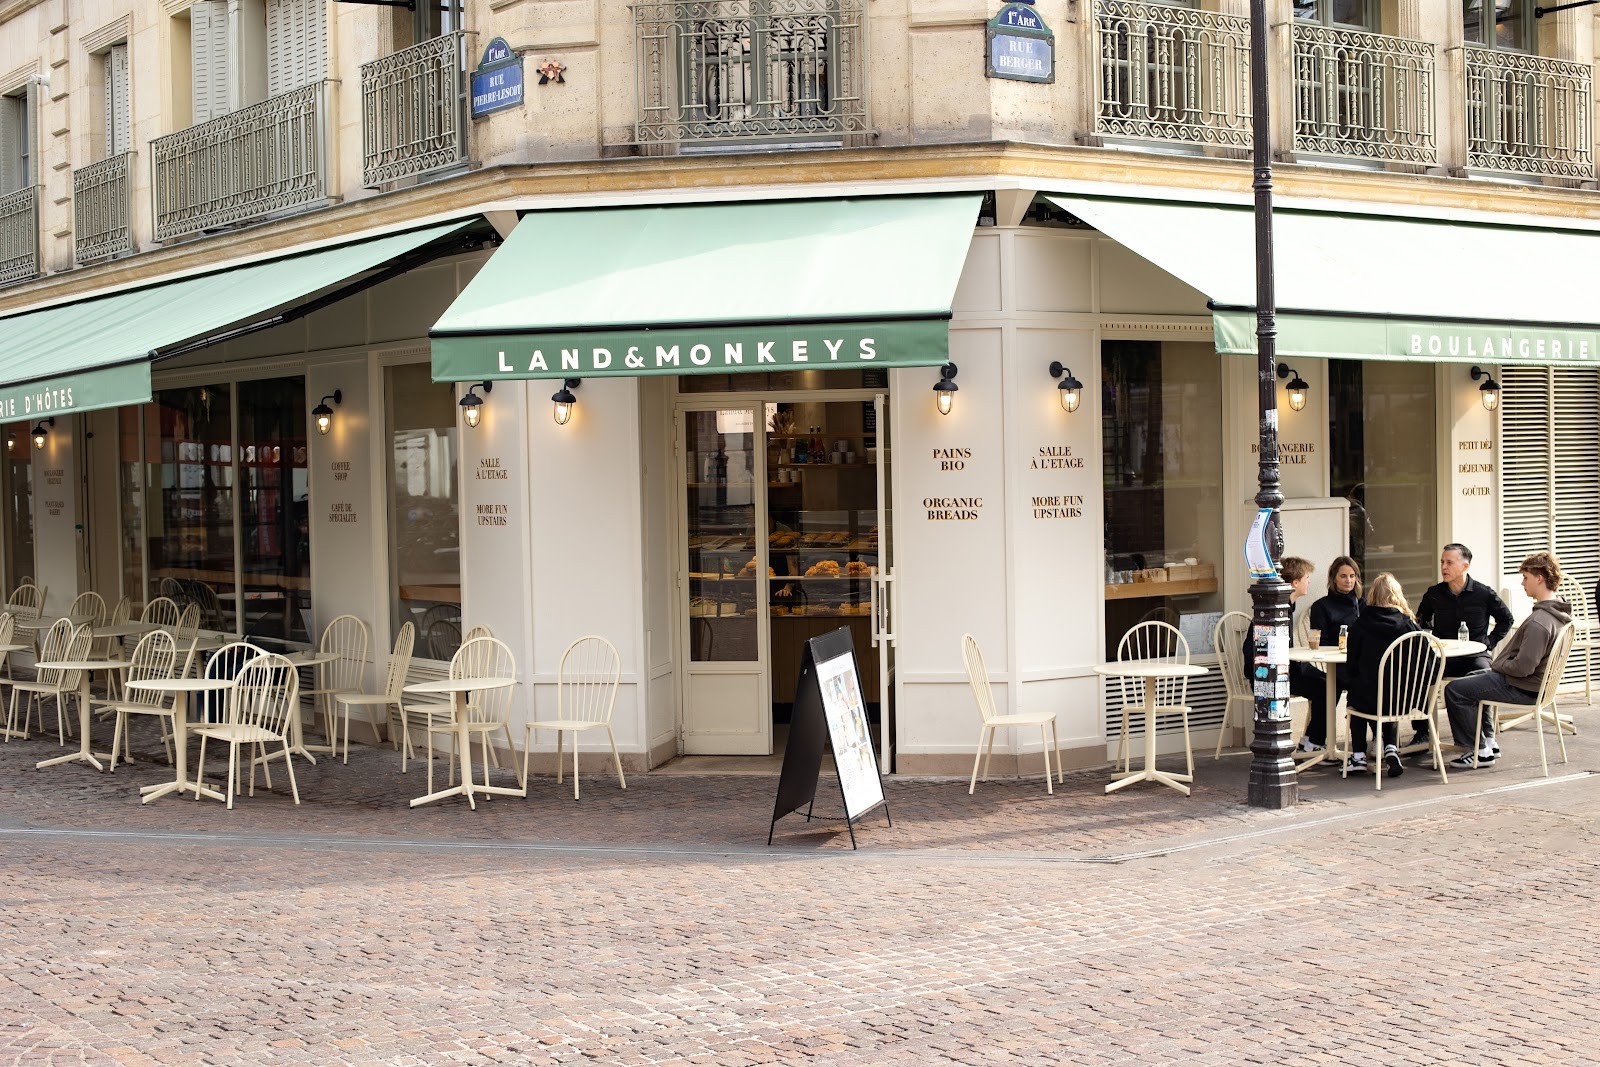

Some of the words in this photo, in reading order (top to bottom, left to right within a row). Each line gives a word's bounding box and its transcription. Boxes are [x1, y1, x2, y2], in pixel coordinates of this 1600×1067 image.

[1010, 41, 1032, 53] RUE
[1000, 56, 1042, 70] BERGER
[490, 74, 504, 87] RUE
[474, 84, 522, 107] PIERRE-LESCOT
[1411, 334, 1588, 359] BOULANGERIE
[498, 338, 877, 372] LAND&MONKEYS
[25, 387, 72, 413] D'HÔTES
[1252, 444, 1314, 453] BANGERIE
[1459, 441, 1479, 450] PETIT
[933, 448, 971, 458] PAINS
[1040, 447, 1072, 456] SALLE
[332, 462, 350, 470] COFFEE
[481, 458, 500, 467] SALLE
[941, 461, 964, 470] BIO
[1031, 457, 1038, 469] À
[1459, 463, 1494, 473] DÉJEUNER
[335, 472, 347, 481] SHOP
[1463, 485, 1490, 496] GOÛTER
[923, 498, 983, 508] ORGANIC
[1032, 496, 1060, 506] MORE
[1064, 496, 1083, 505] FUN
[332, 501, 344, 512] CAFÉ
[346, 504, 352, 512] DE
[477, 505, 493, 513] MORE
[496, 505, 507, 513] FUN
[928, 510, 978, 520] BREADS
[1034, 508, 1082, 519] UPSTAIRS
[478, 516, 506, 525] UPSTAIRS
